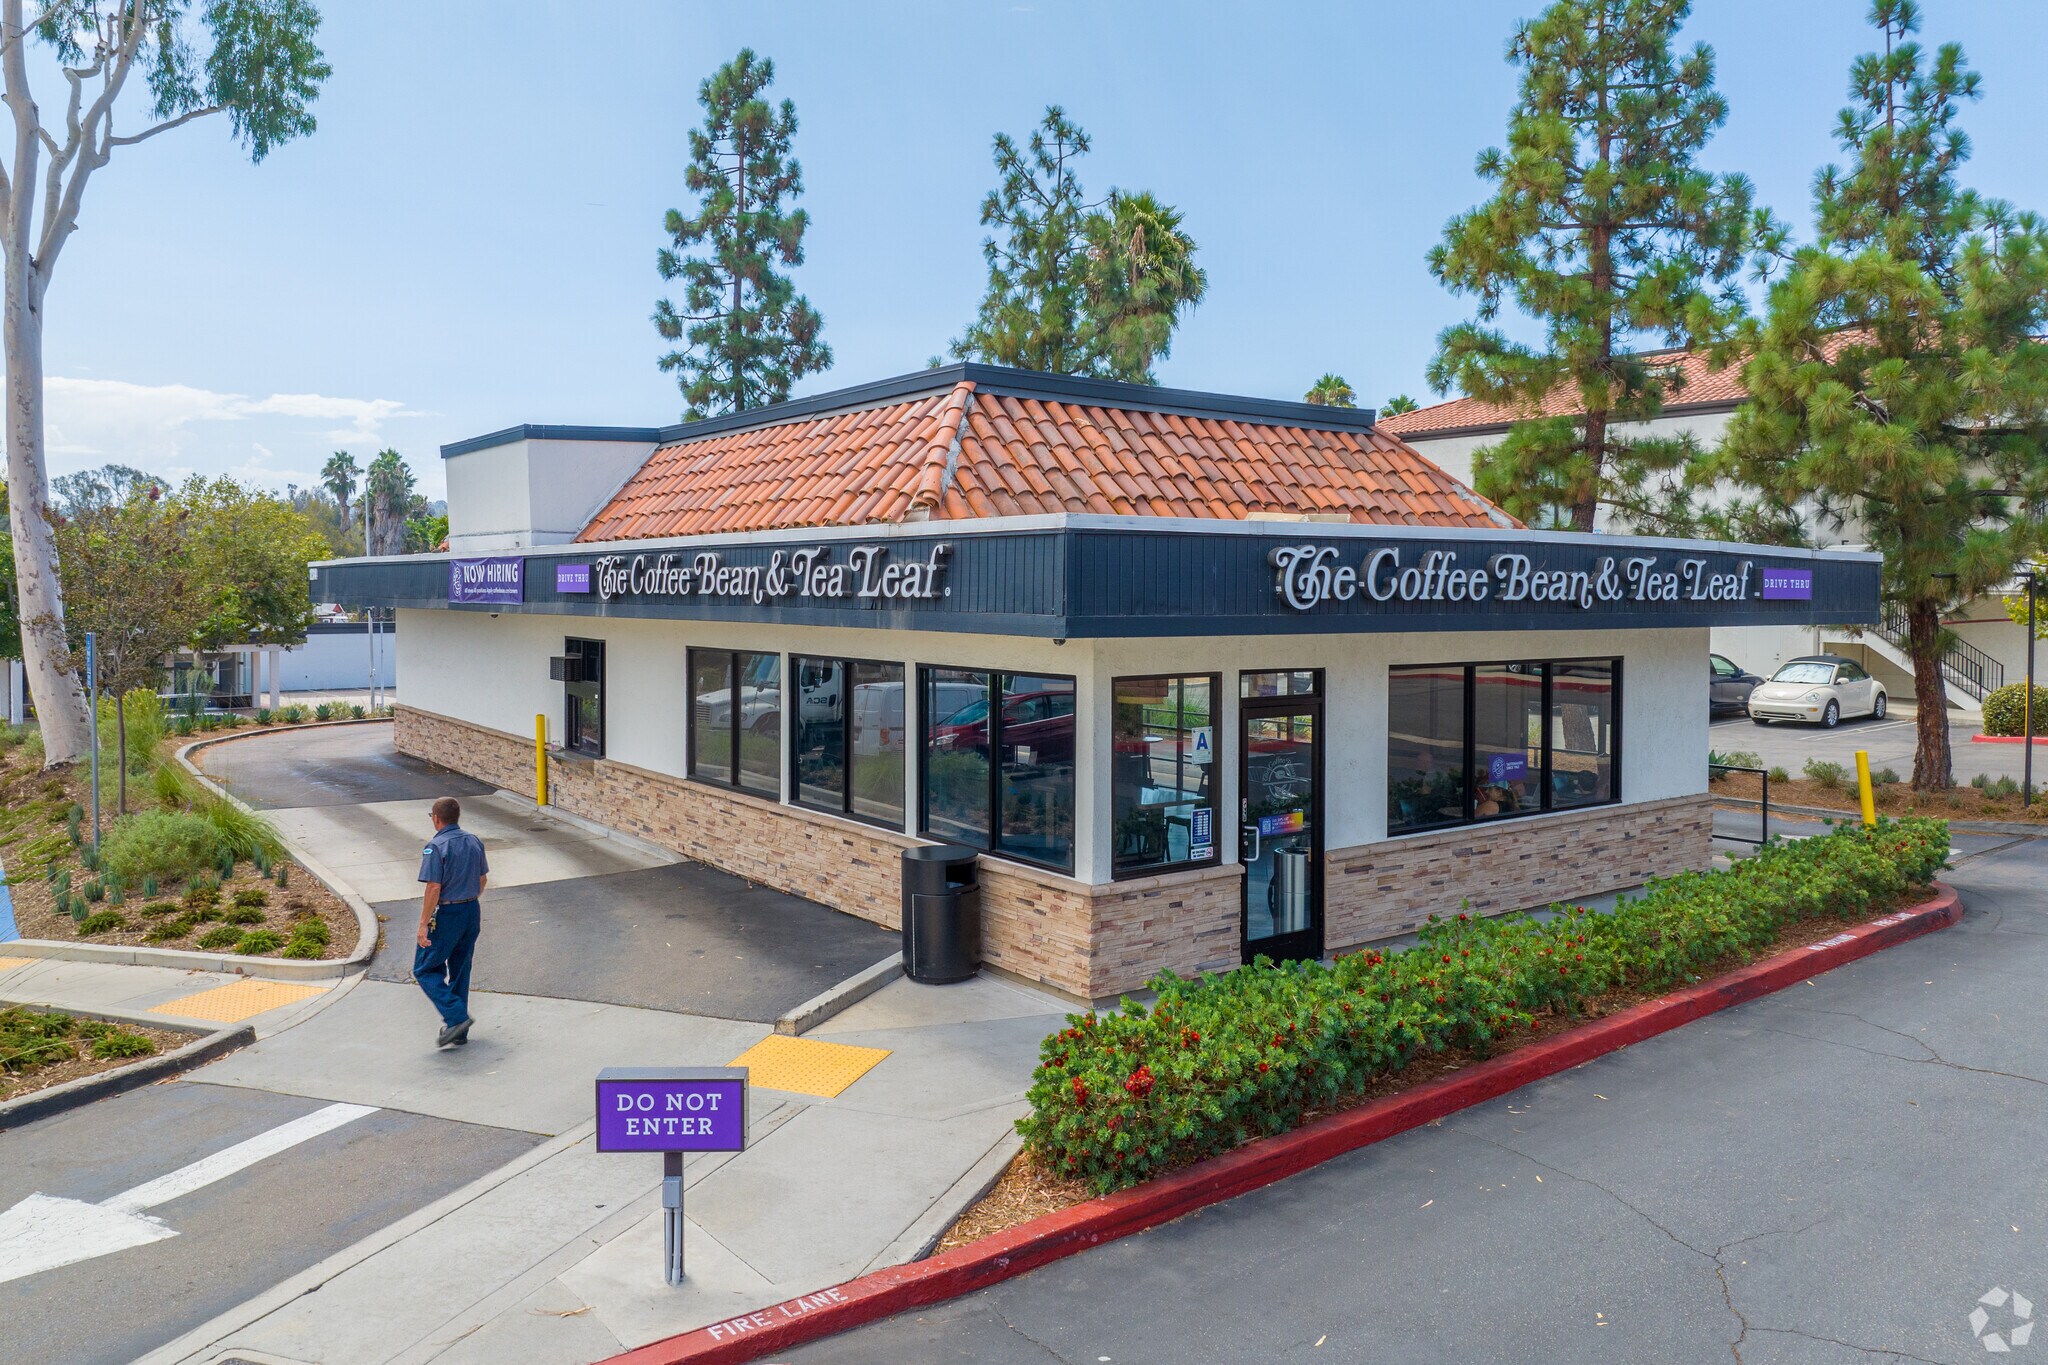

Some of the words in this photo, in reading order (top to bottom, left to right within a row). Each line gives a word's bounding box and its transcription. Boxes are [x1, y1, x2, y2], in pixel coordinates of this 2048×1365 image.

[463, 564, 485, 584] NOW
[487, 563, 519, 583] HIRING
[596, 555, 627, 600] The
[631, 554, 690, 595] Coffee
[694, 553, 763, 604] Bean
[766, 550, 789, 596] &
[792, 546, 843, 597] Tea
[850, 544, 944, 598] Leaf
[1276, 545, 1356, 610] The
[1368, 547, 1488, 601] Coffee
[1495, 554, 1593, 609] Bean
[1596, 556, 1623, 601] &
[1627, 556, 1679, 601] Tea
[1683, 558, 1753, 601] Leaf
[1764, 578, 1788, 589] DRIVE
[1790, 579, 1810, 589] THRU
[1196, 732, 1209, 750] A
[617, 1093, 655, 1112] DO
[666, 1093, 722, 1111] NOT
[626, 1117, 713, 1136] ENTER
[707, 1312, 773, 1341] FIRE
[778, 1287, 849, 1318] LANE
